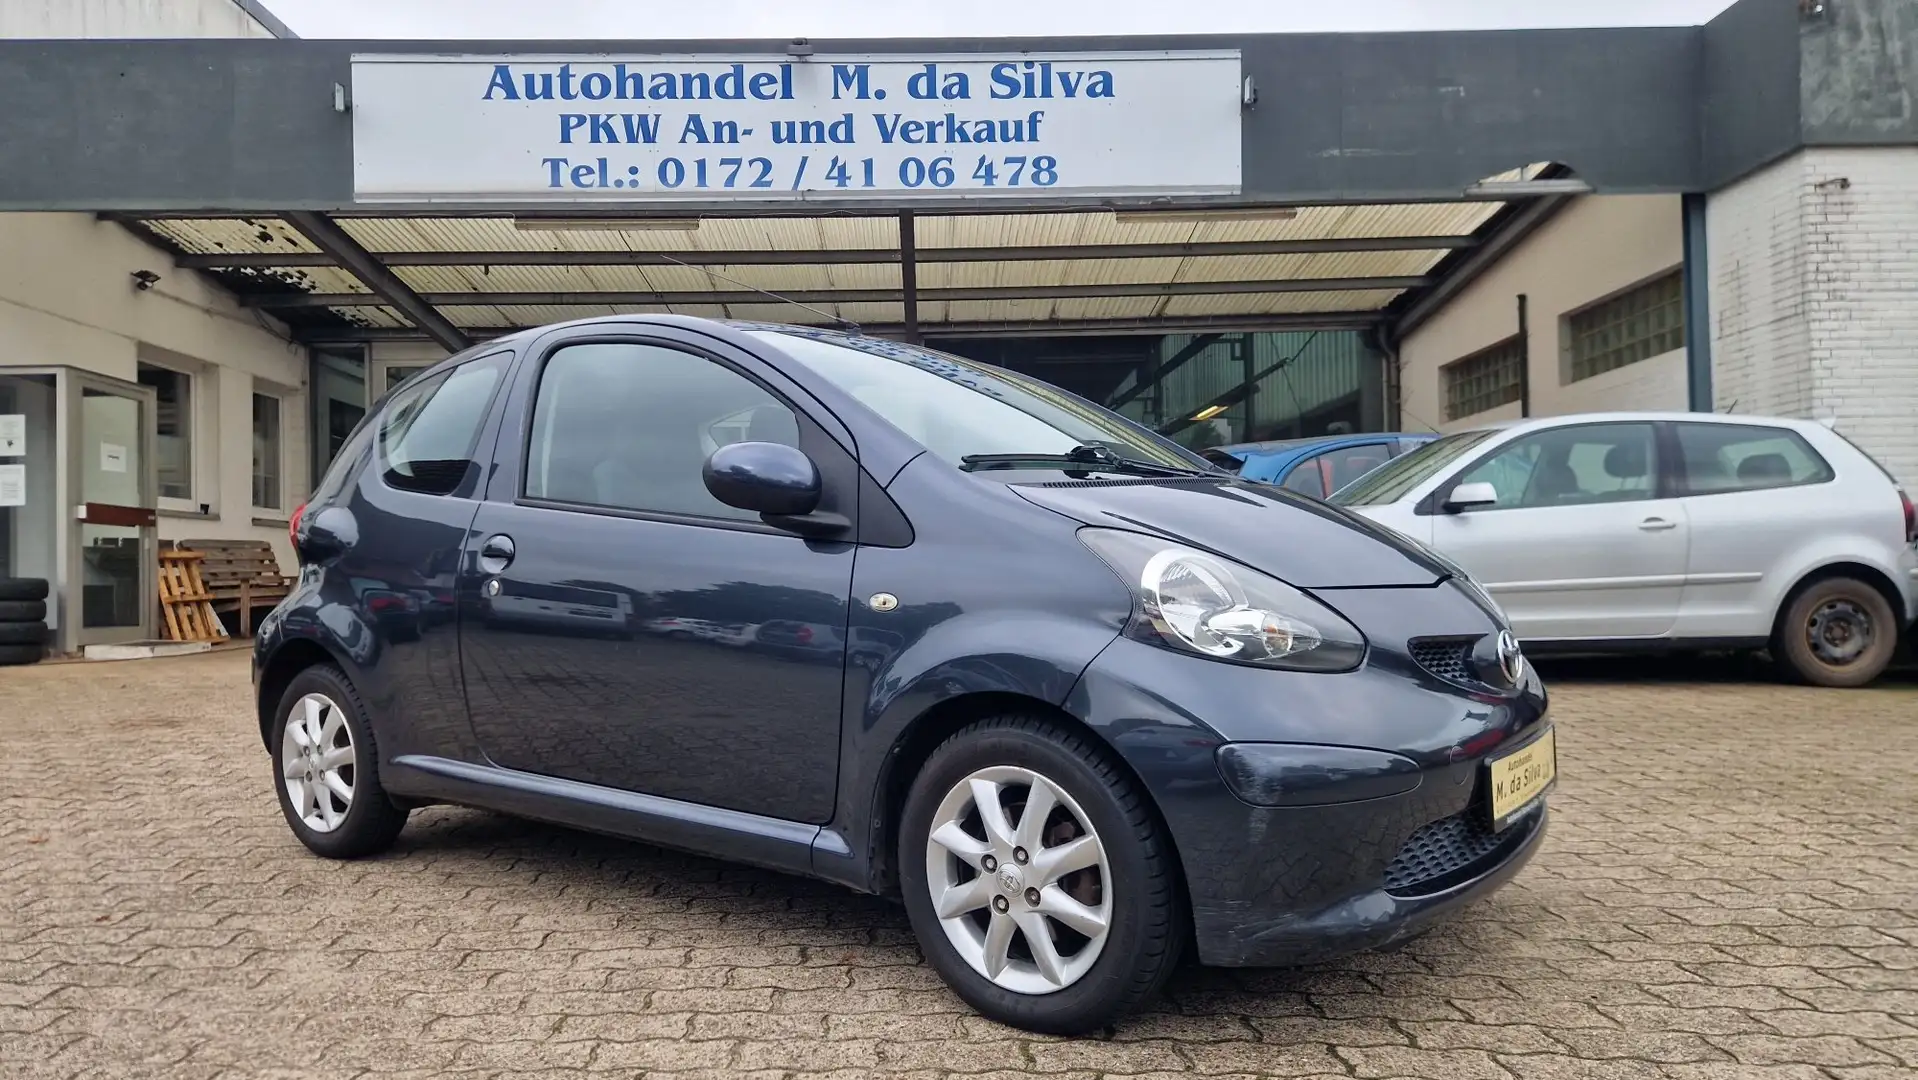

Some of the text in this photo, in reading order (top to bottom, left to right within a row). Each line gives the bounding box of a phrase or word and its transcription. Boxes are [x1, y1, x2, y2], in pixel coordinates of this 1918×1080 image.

[483, 62, 1116, 101] Autohandel M. da Silva
[558, 111, 1045, 144] PKW An- und Verkauf
[541, 154, 1059, 191] Tel.: 0172 / 41 06 478
[1496, 781, 1507, 803] M.
[1510, 774, 1521, 795] da
[1523, 764, 1541, 788] Silva
